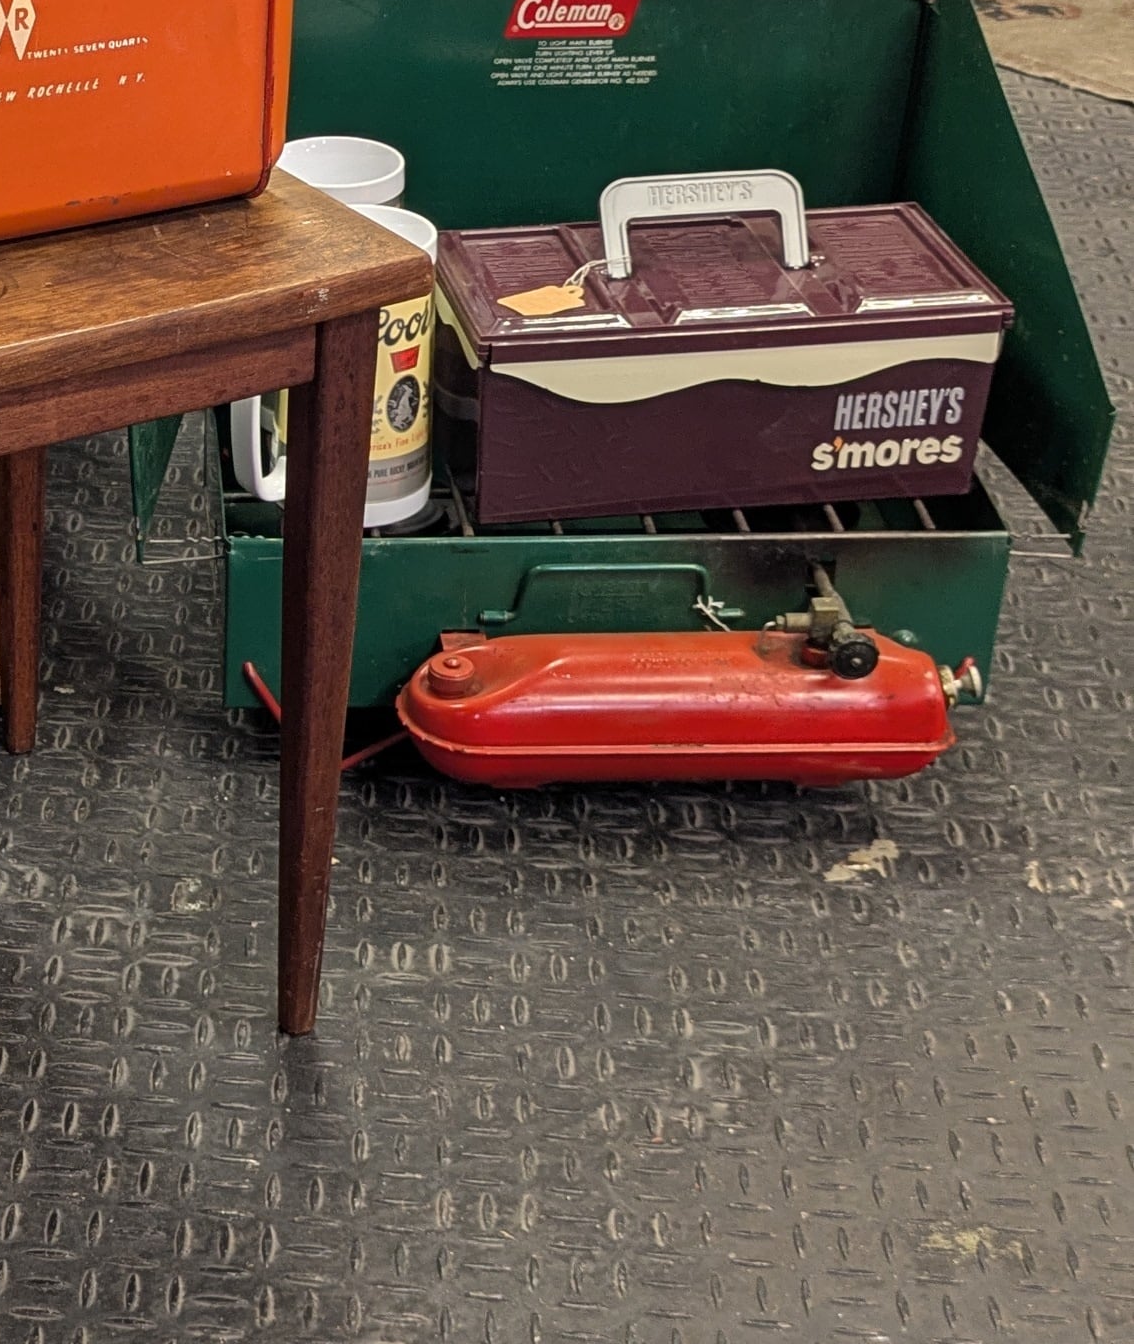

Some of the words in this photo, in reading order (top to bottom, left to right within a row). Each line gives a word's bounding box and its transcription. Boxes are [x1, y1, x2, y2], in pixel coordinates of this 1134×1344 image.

[73, 42, 106, 54] SEVEN
[27, 78, 100, 99] ROCHELLE
[647, 180, 754, 206] HERSHEY'S
[833, 386, 965, 431] HERSHEY'S
[810, 434, 964, 471] s'mores
